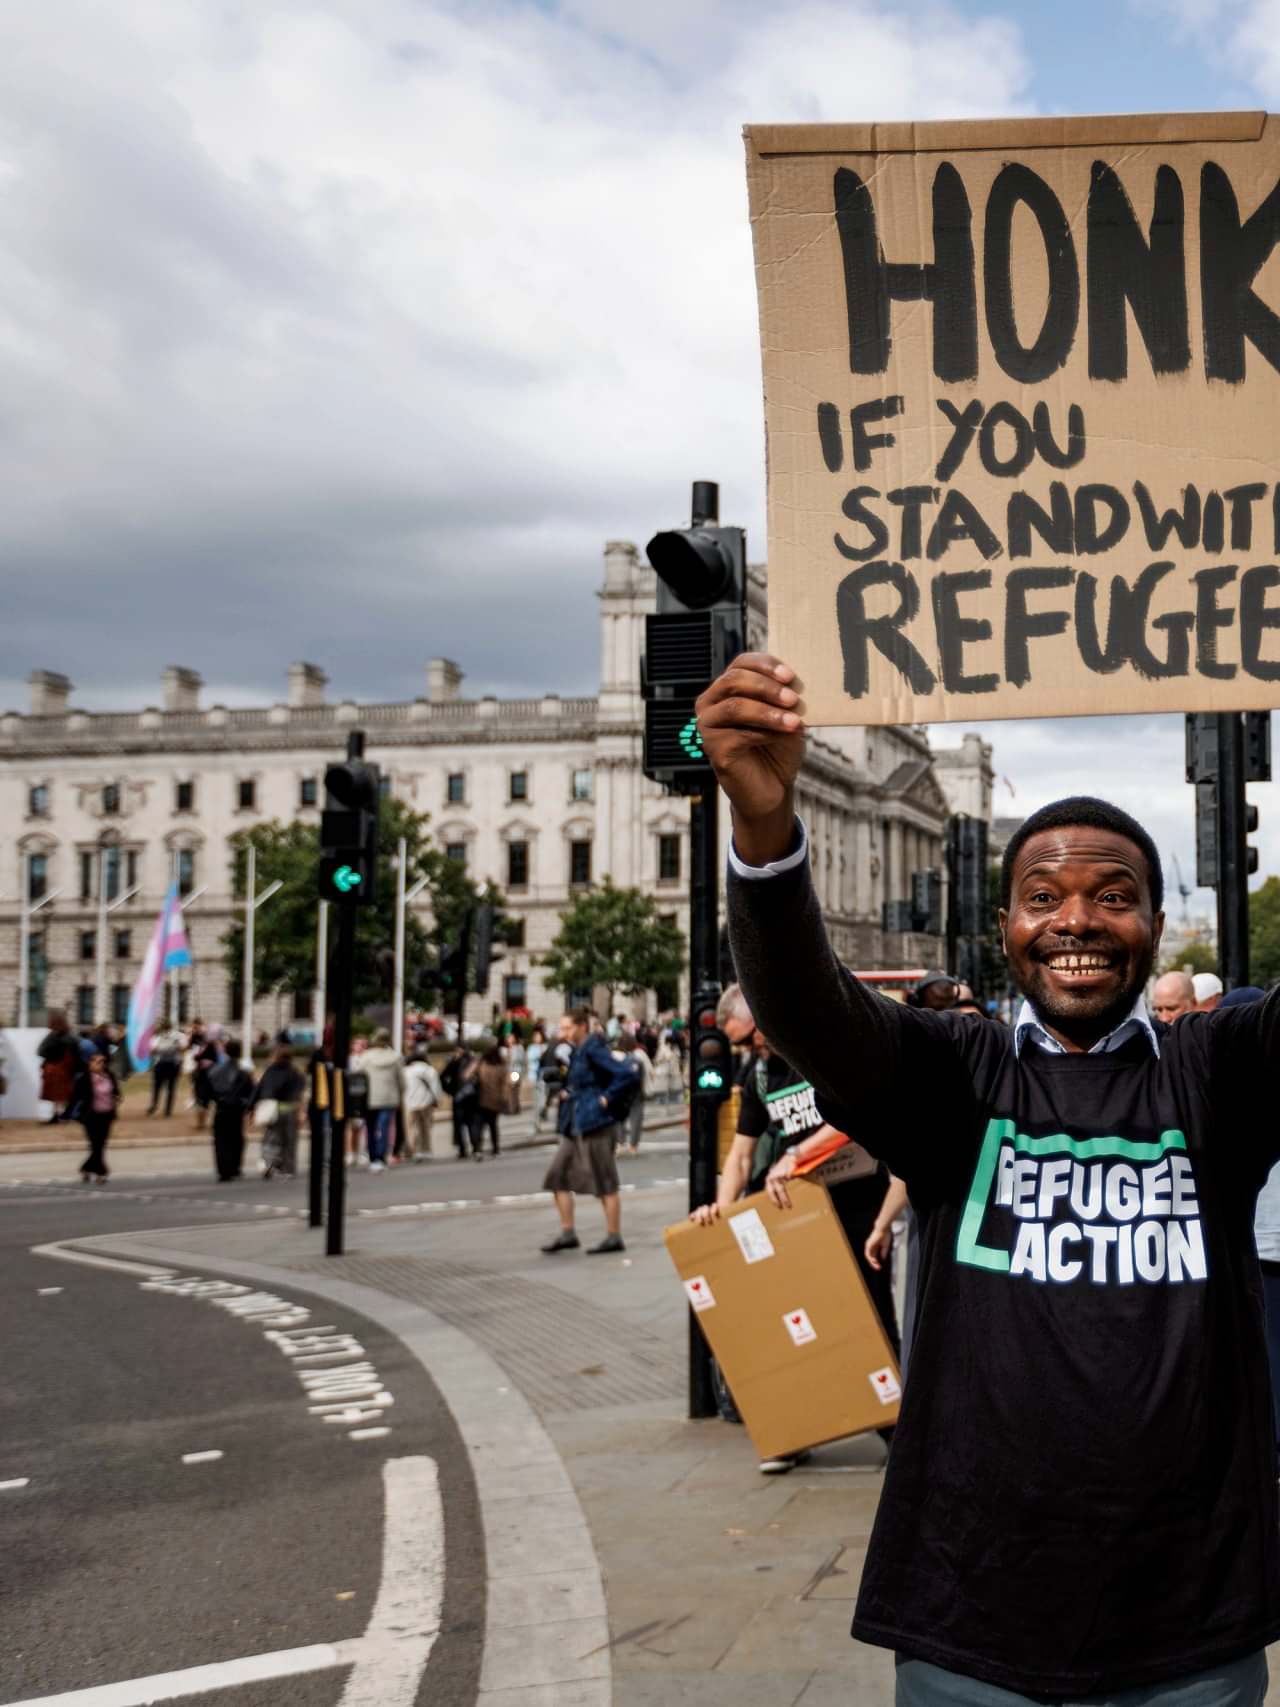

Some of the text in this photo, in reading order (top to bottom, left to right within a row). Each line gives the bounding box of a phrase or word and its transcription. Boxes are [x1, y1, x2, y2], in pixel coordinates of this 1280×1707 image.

[818, 396, 1086, 481] IF YOU
[995, 1145, 1200, 1221] REFUGEE
[1010, 1219, 1208, 1284] ACTION
